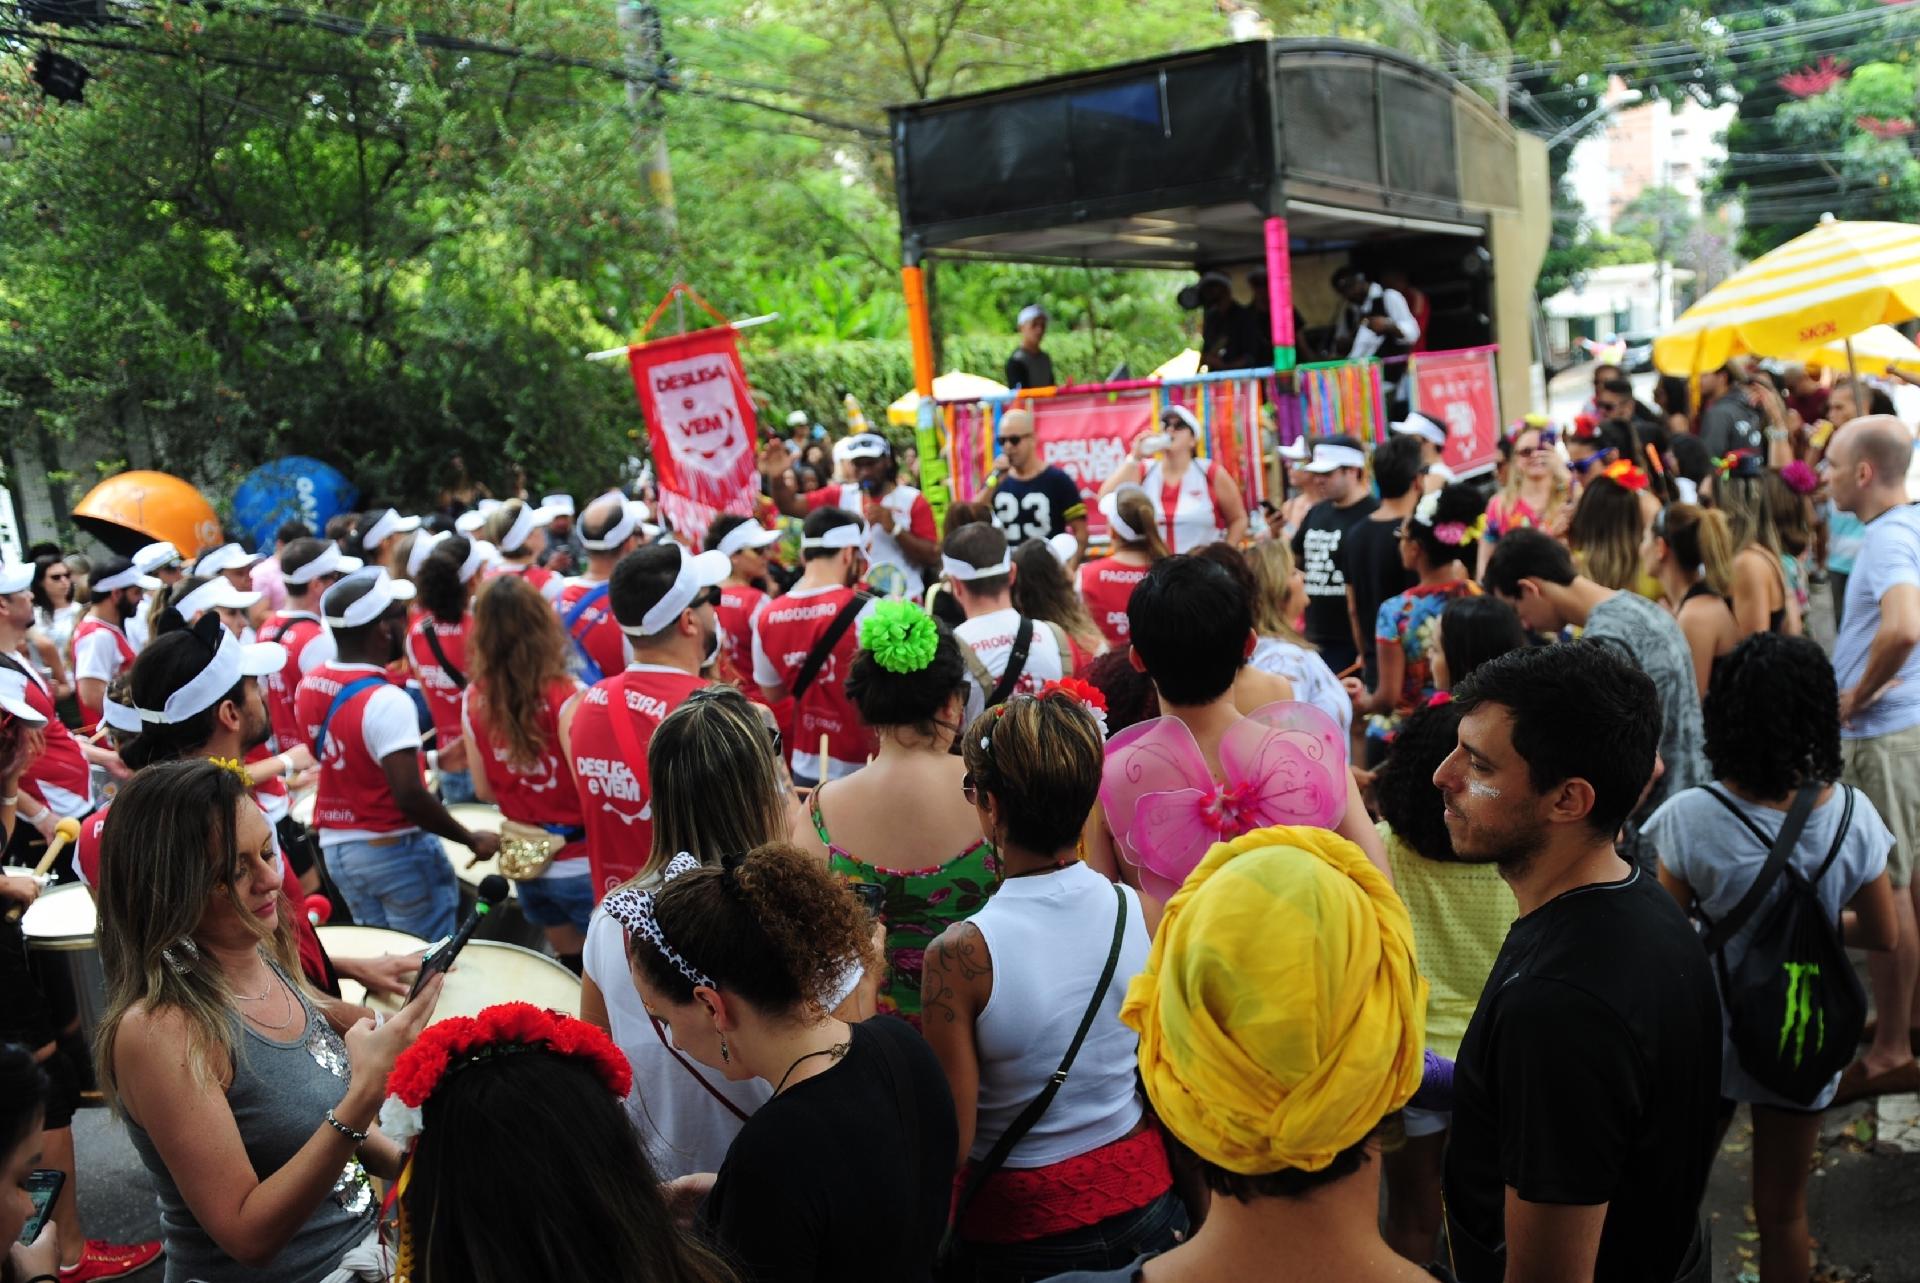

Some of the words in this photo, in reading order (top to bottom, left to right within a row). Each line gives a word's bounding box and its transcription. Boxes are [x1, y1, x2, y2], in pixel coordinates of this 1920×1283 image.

[656, 364, 726, 392] DESLIGA
[679, 415, 724, 437] VEM
[994, 491, 1052, 541] 23
[588, 778, 600, 795] e
[600, 776, 641, 802] VEM
